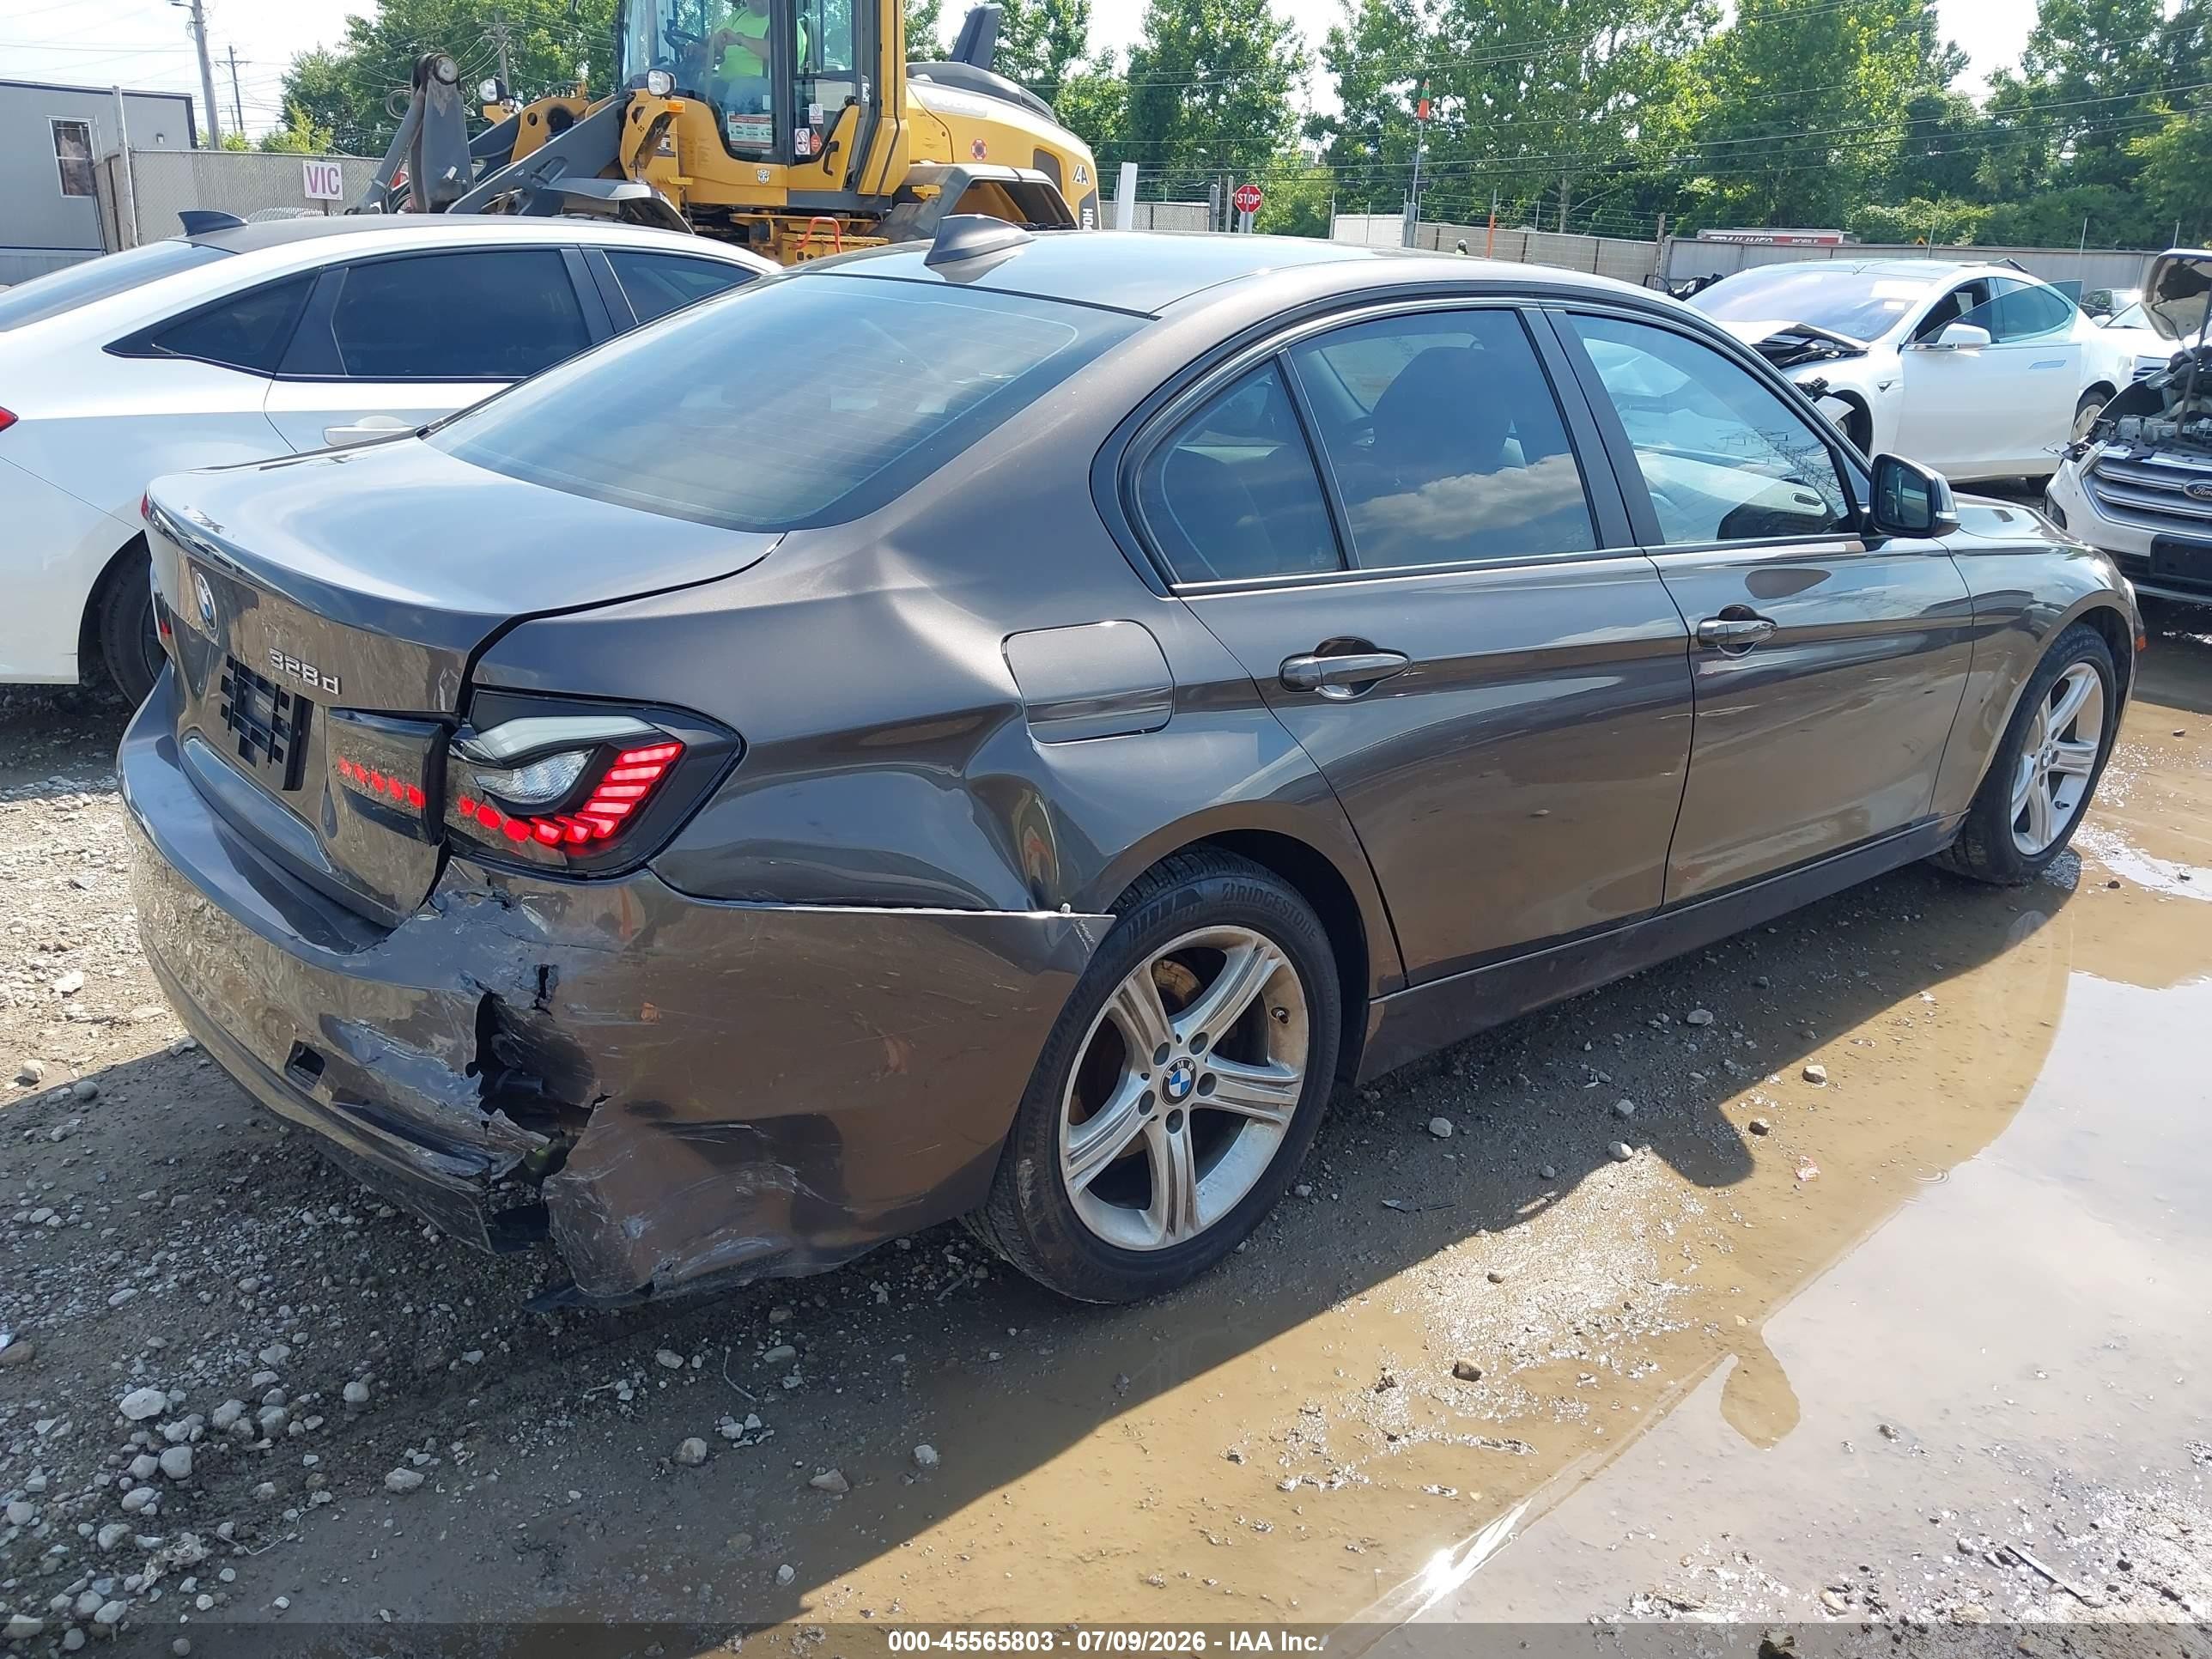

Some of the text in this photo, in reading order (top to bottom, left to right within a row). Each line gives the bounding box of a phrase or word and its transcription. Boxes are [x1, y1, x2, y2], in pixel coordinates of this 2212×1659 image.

[306, 166, 340, 195] VIC
[1237, 193, 1261, 205] STOP
[268, 647, 341, 696] 328d
[1222, 882, 1317, 943] BRIDGESTONE
[1165, 1060, 1195, 1079] BMW
